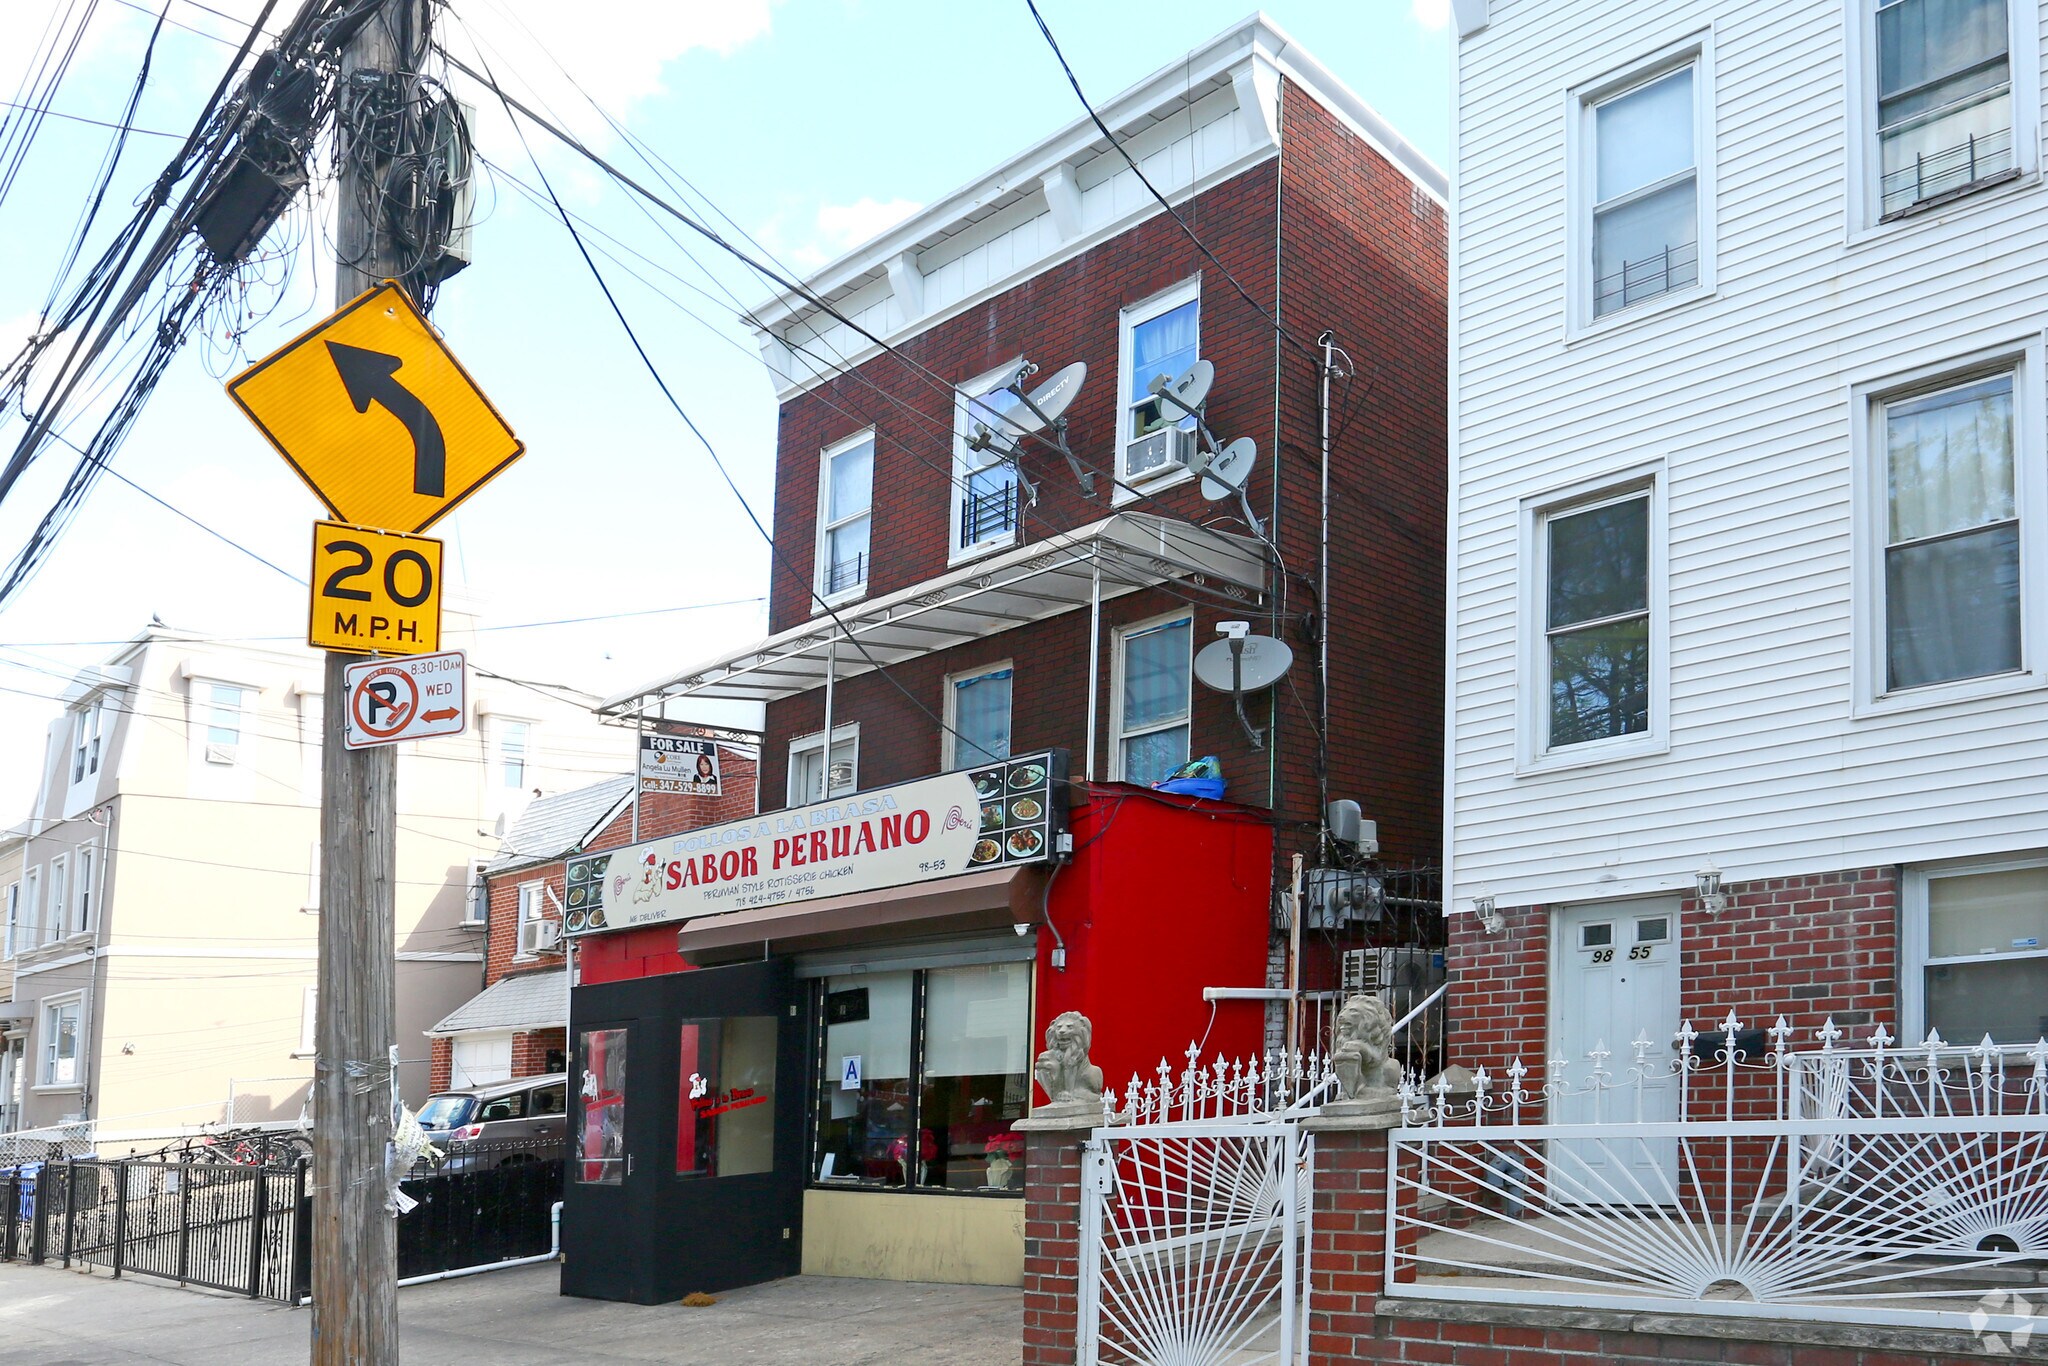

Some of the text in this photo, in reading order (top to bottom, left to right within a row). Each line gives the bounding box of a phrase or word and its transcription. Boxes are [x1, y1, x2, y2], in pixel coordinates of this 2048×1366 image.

[1037, 376, 1069, 406] DIRECTV
[322, 540, 432, 607] 20
[334, 612, 423, 643] M.P.H.
[411, 659, 461, 675] 8:30-10AM
[426, 682, 453, 697] WED
[650, 737, 705, 755] FOR SALE
[642, 762, 663, 772] Angela
[643, 780, 716, 794] Cell: 347-529-8899
[673, 794, 898, 855] POLLOS A LA BRASA
[666, 809, 931, 891] SABOR PERUANO
[919, 859, 946, 873] 98-53
[703, 863, 855, 900] PERUVIAN STYLE ROTISSERIE CHICKEN
[735, 898, 747, 907] 718
[749, 892, 786, 905] 424-4755
[796, 886, 815, 897] 4756
[629, 910, 667, 923] WE DELIVER
[1593, 946, 1652, 963] 98 55
[845, 1060, 858, 1080] A
